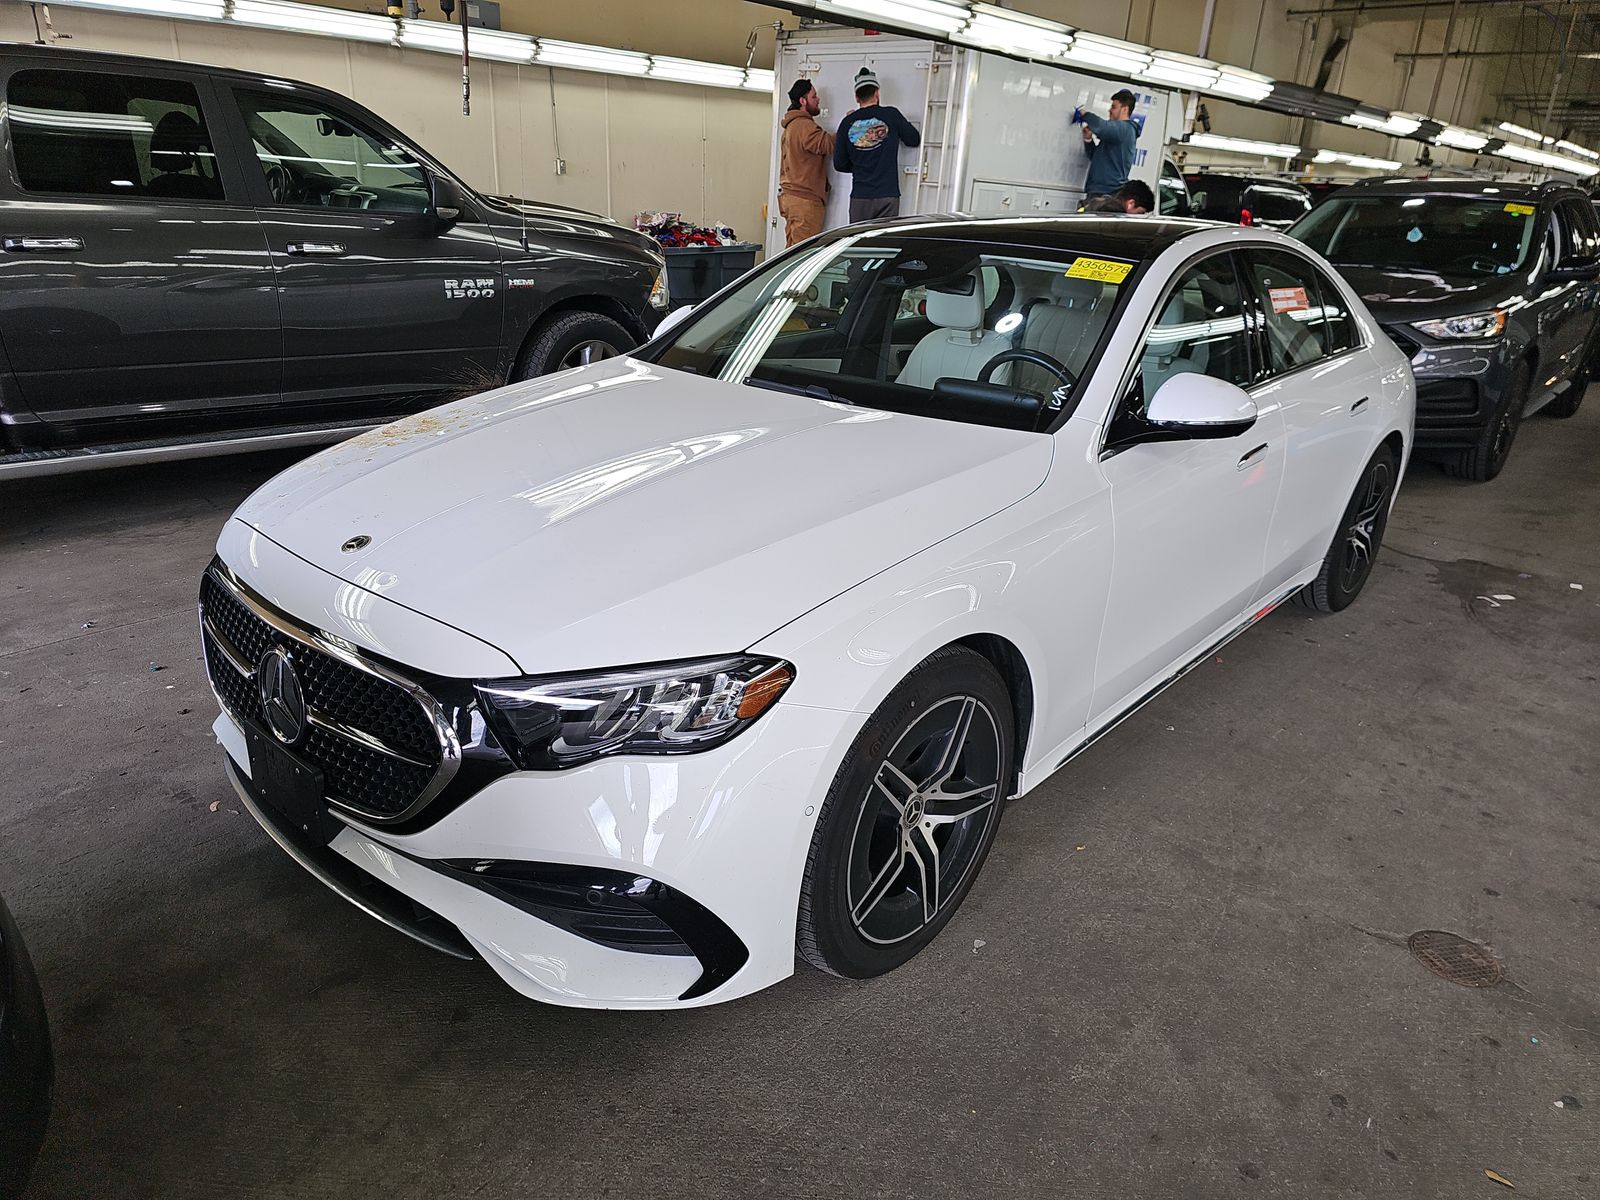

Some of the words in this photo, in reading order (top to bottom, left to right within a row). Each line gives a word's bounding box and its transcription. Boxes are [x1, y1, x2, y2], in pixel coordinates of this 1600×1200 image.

[1076, 260, 1131, 274] 4350578
[444, 279, 494, 289] RAM
[445, 289, 495, 299] 1500
[869, 693, 921, 759] Continen
